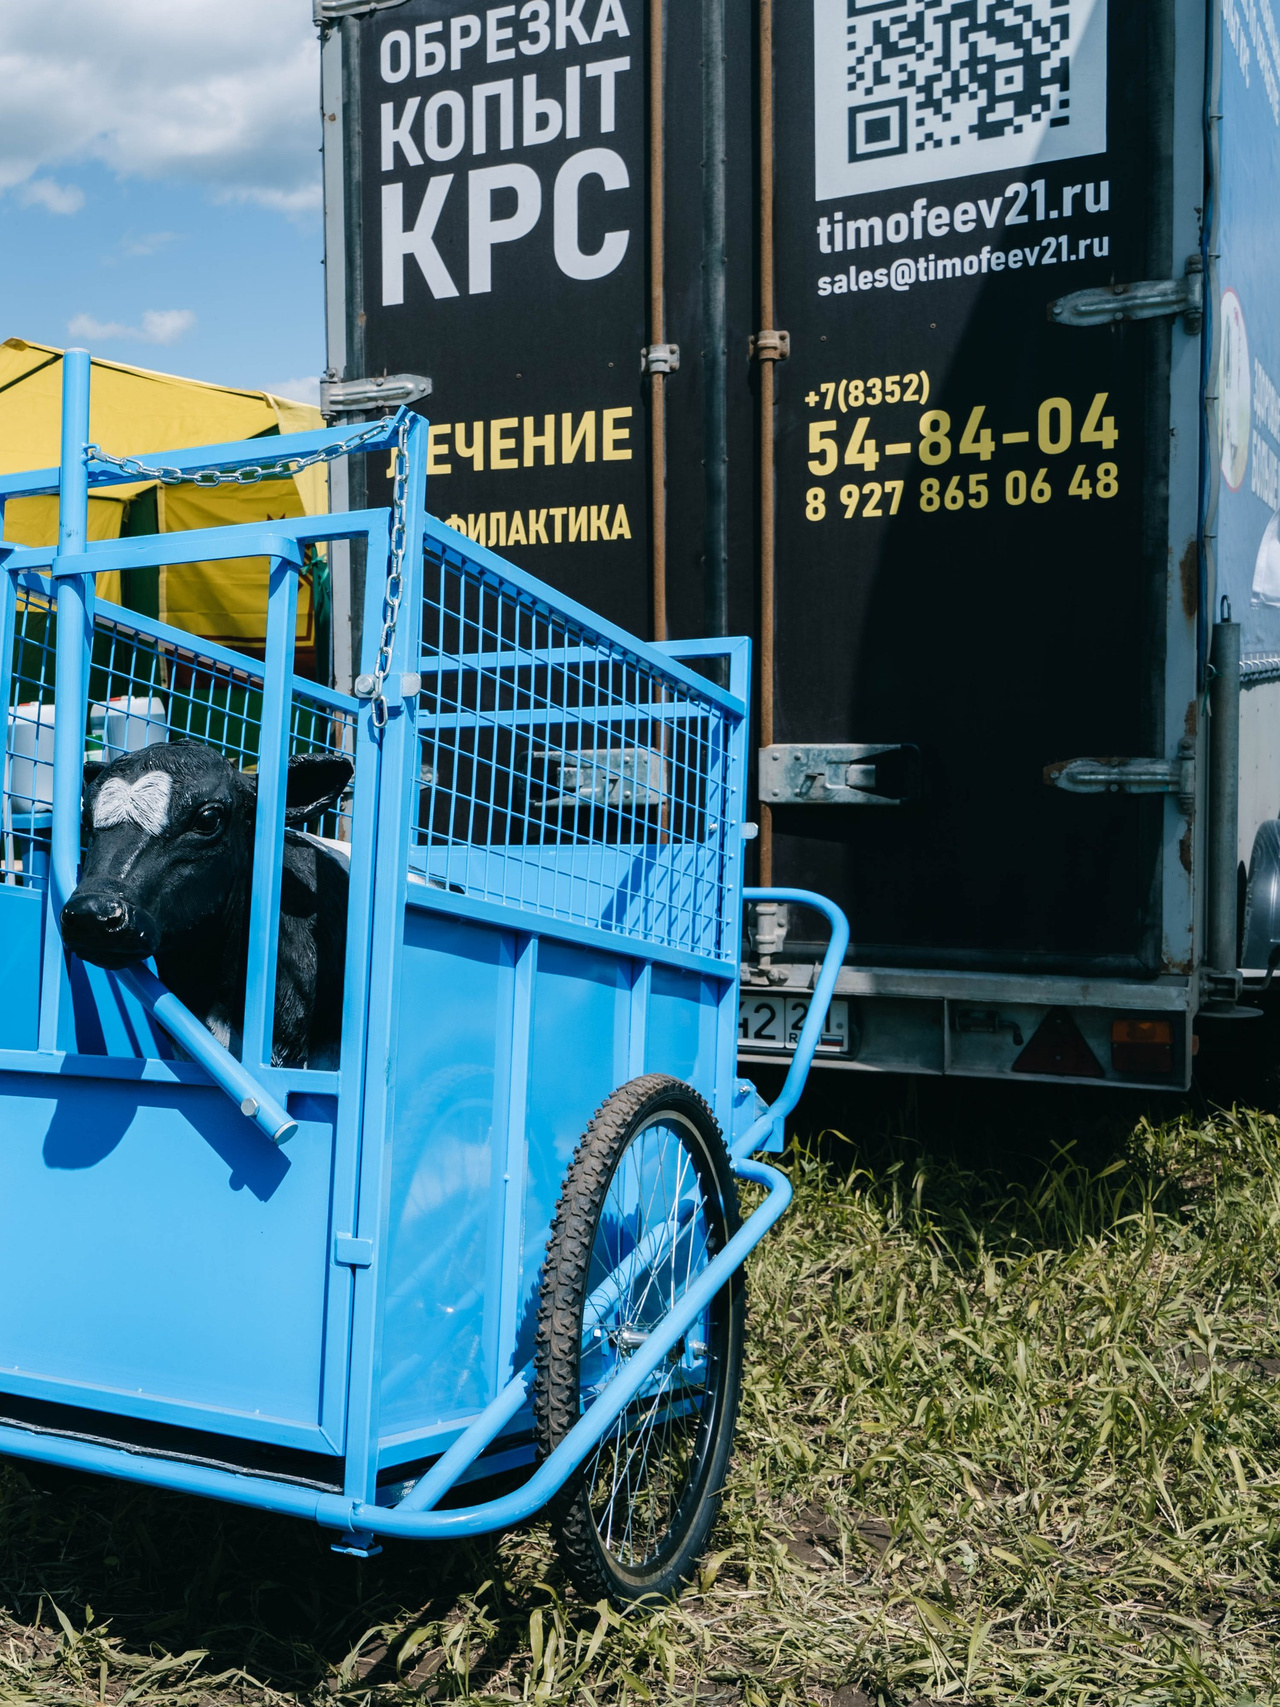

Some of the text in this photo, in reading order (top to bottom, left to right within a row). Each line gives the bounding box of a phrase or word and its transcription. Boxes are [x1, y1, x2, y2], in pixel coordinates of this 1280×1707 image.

[379, 0, 631, 84] ОБРЕЗКА
[380, 55, 631, 172] КОПЫТ
[380, 147, 631, 307] КРС
[816, 178, 1110, 255] timofeev21.ru
[816, 234, 1110, 297] sales@timofeev21.ru
[804, 369, 931, 413] +7(8352)
[807, 392, 1120, 477] 54-84-04
[437, 503, 633, 548] ФИЛАКТИКА
[805, 461, 1119, 522] 8 927 865 06 48
